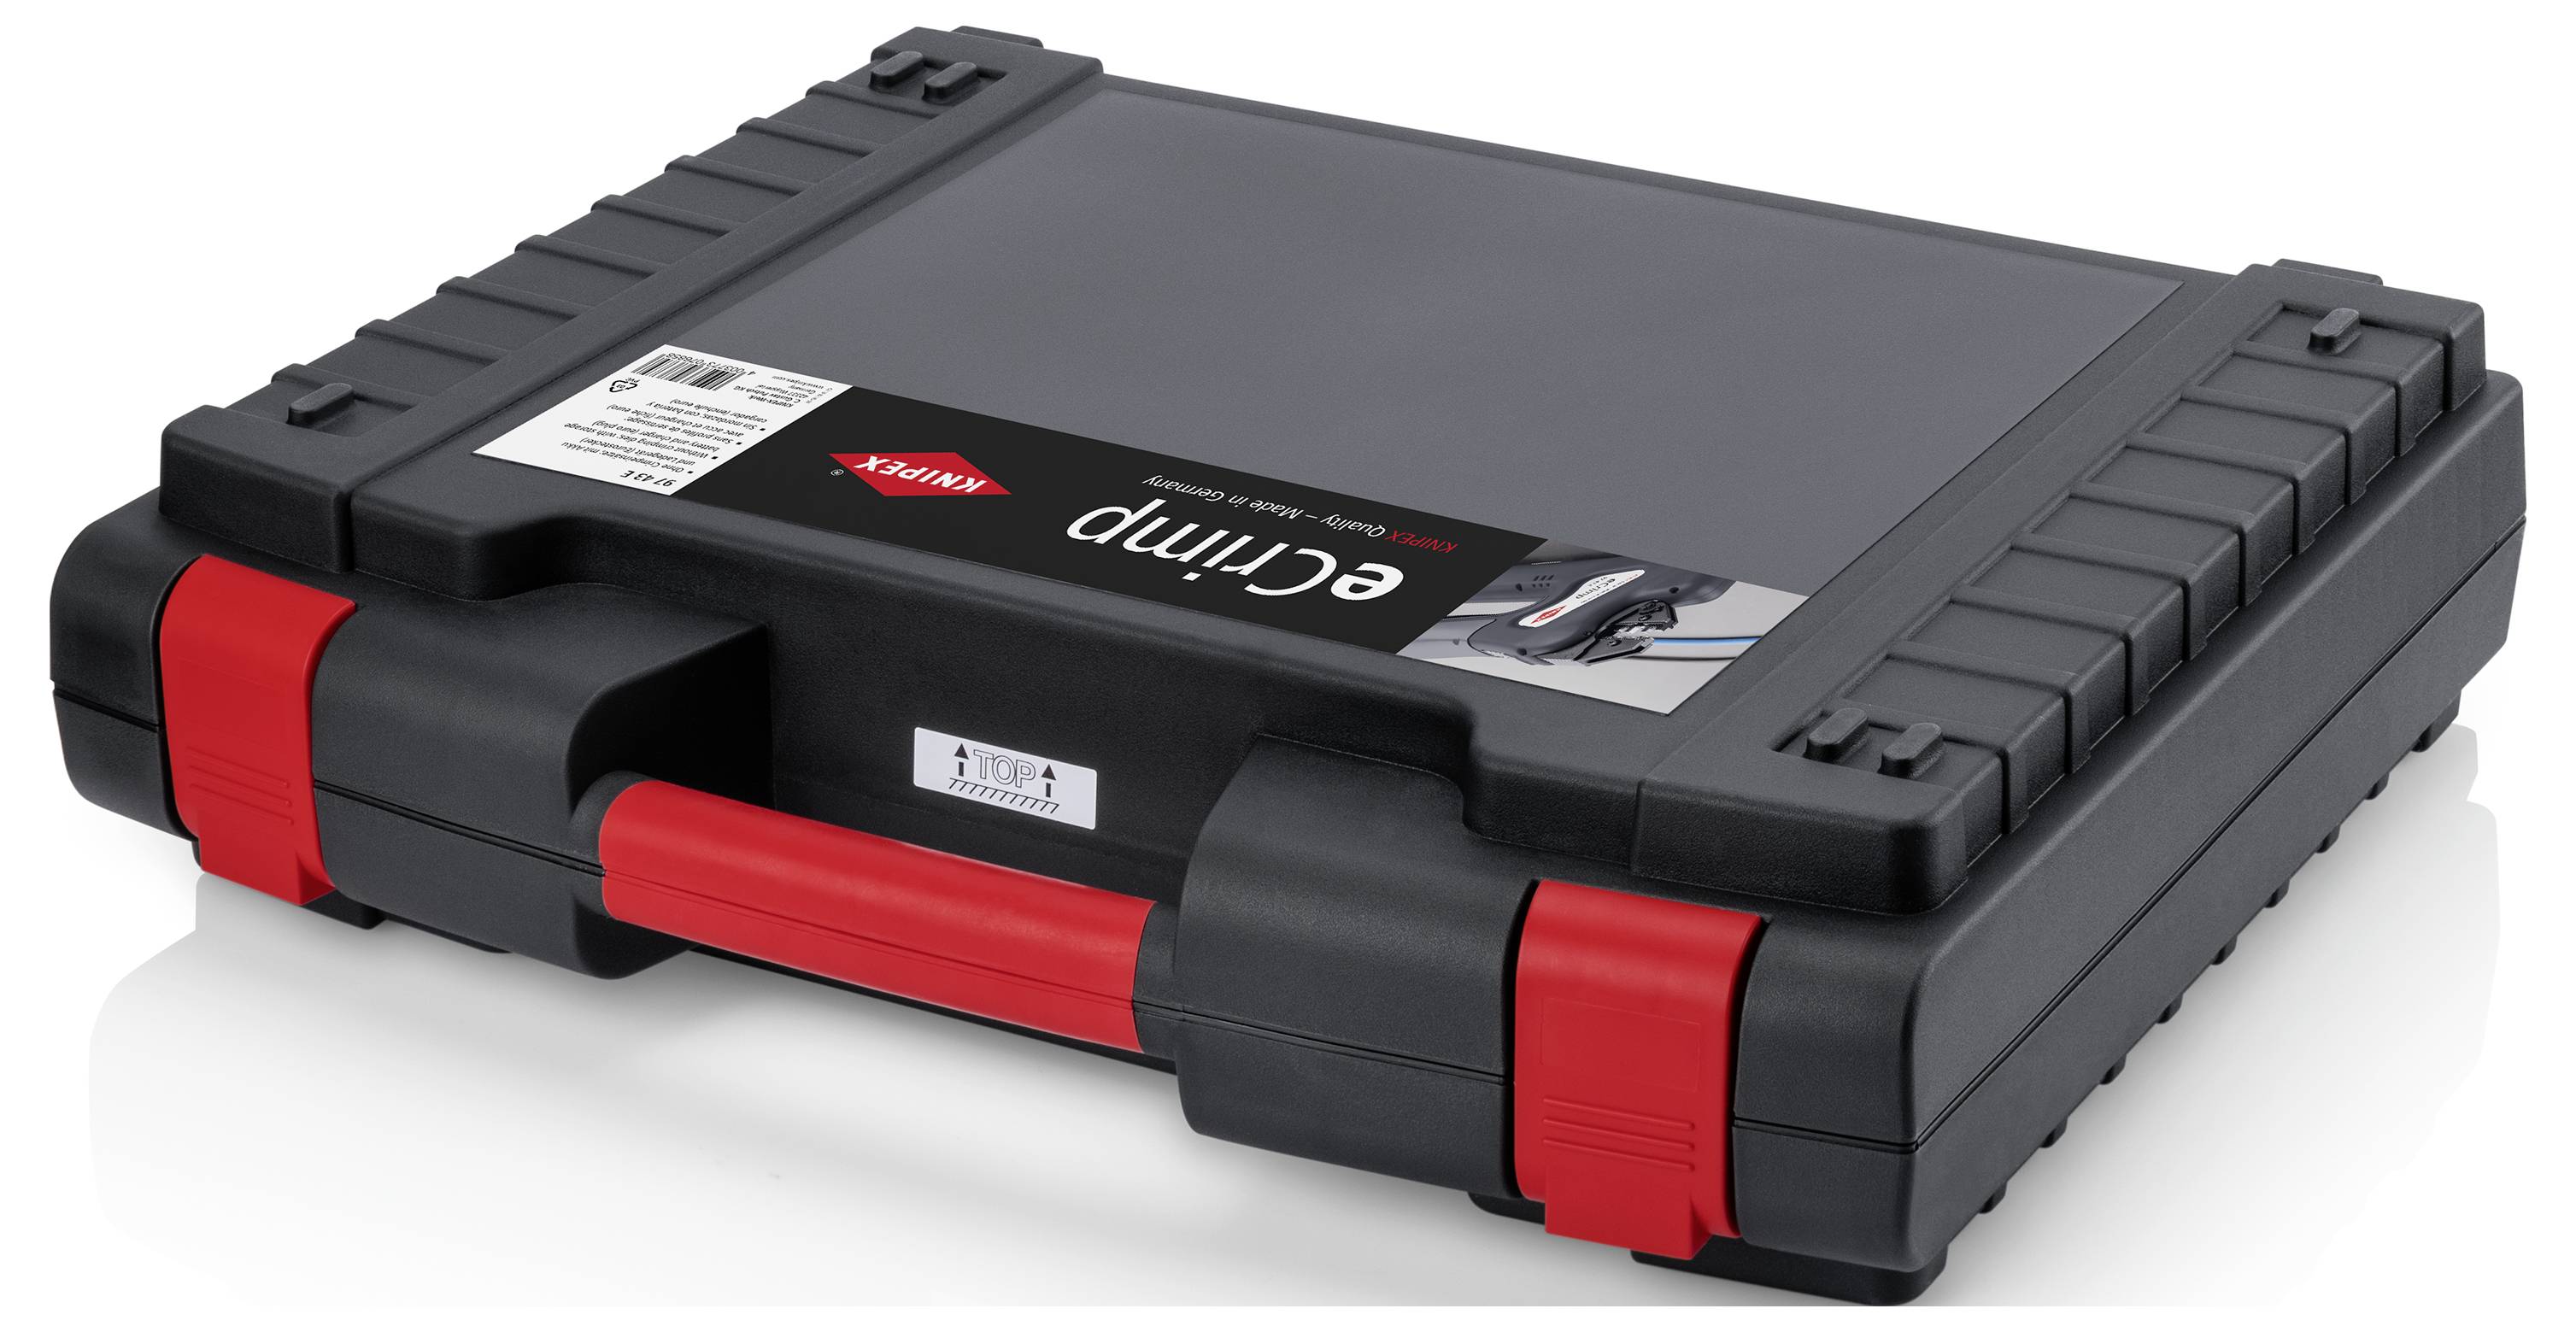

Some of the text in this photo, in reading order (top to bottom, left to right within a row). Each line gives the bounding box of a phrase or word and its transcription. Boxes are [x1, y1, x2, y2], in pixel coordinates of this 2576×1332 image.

[664, 353, 704, 366] 076858
[707, 362, 744, 373] 003773
[746, 388, 769, 396] Putsch
[768, 393, 794, 402] Gustav
[606, 403, 631, 413] euro)
[669, 398, 767, 423] cargador (enchufe euro)
[631, 410, 656, 419] (fiche
[592, 420, 619, 429] plug)
[654, 415, 692, 426] chargeur
[564, 423, 597, 432] storage
[615, 425, 641, 435] (euro
[701, 425, 725, 433] accu
[742, 422, 758, 431] Sin
[596, 430, 617, 438] with
[638, 431, 672, 441] charger
[680, 429, 715, 438] profiles
[722, 429, 745, 437] avec
[637, 438, 674, 449] crimping
[713, 436, 734, 444] Sans
[560, 442, 586, 451] Akku
[579, 437, 696, 466] und Ladegerät (Eurostecker)
[689, 442, 719, 452] battery
[674, 448, 708, 458] Without
[661, 464, 684, 472] Ohne
[619, 470, 677, 487] 97 43 E
[854, 455, 987, 493] KNIPEX
[1142, 474, 1224, 502] Germany
[1228, 493, 1247, 507] in
[1248, 499, 1304, 519] Made
[1320, 513, 1386, 538] Quality
[1386, 530, 1458, 554] KNIPEX
[1066, 498, 1404, 601] eCrimp
[973, 749, 1036, 788] TOP
